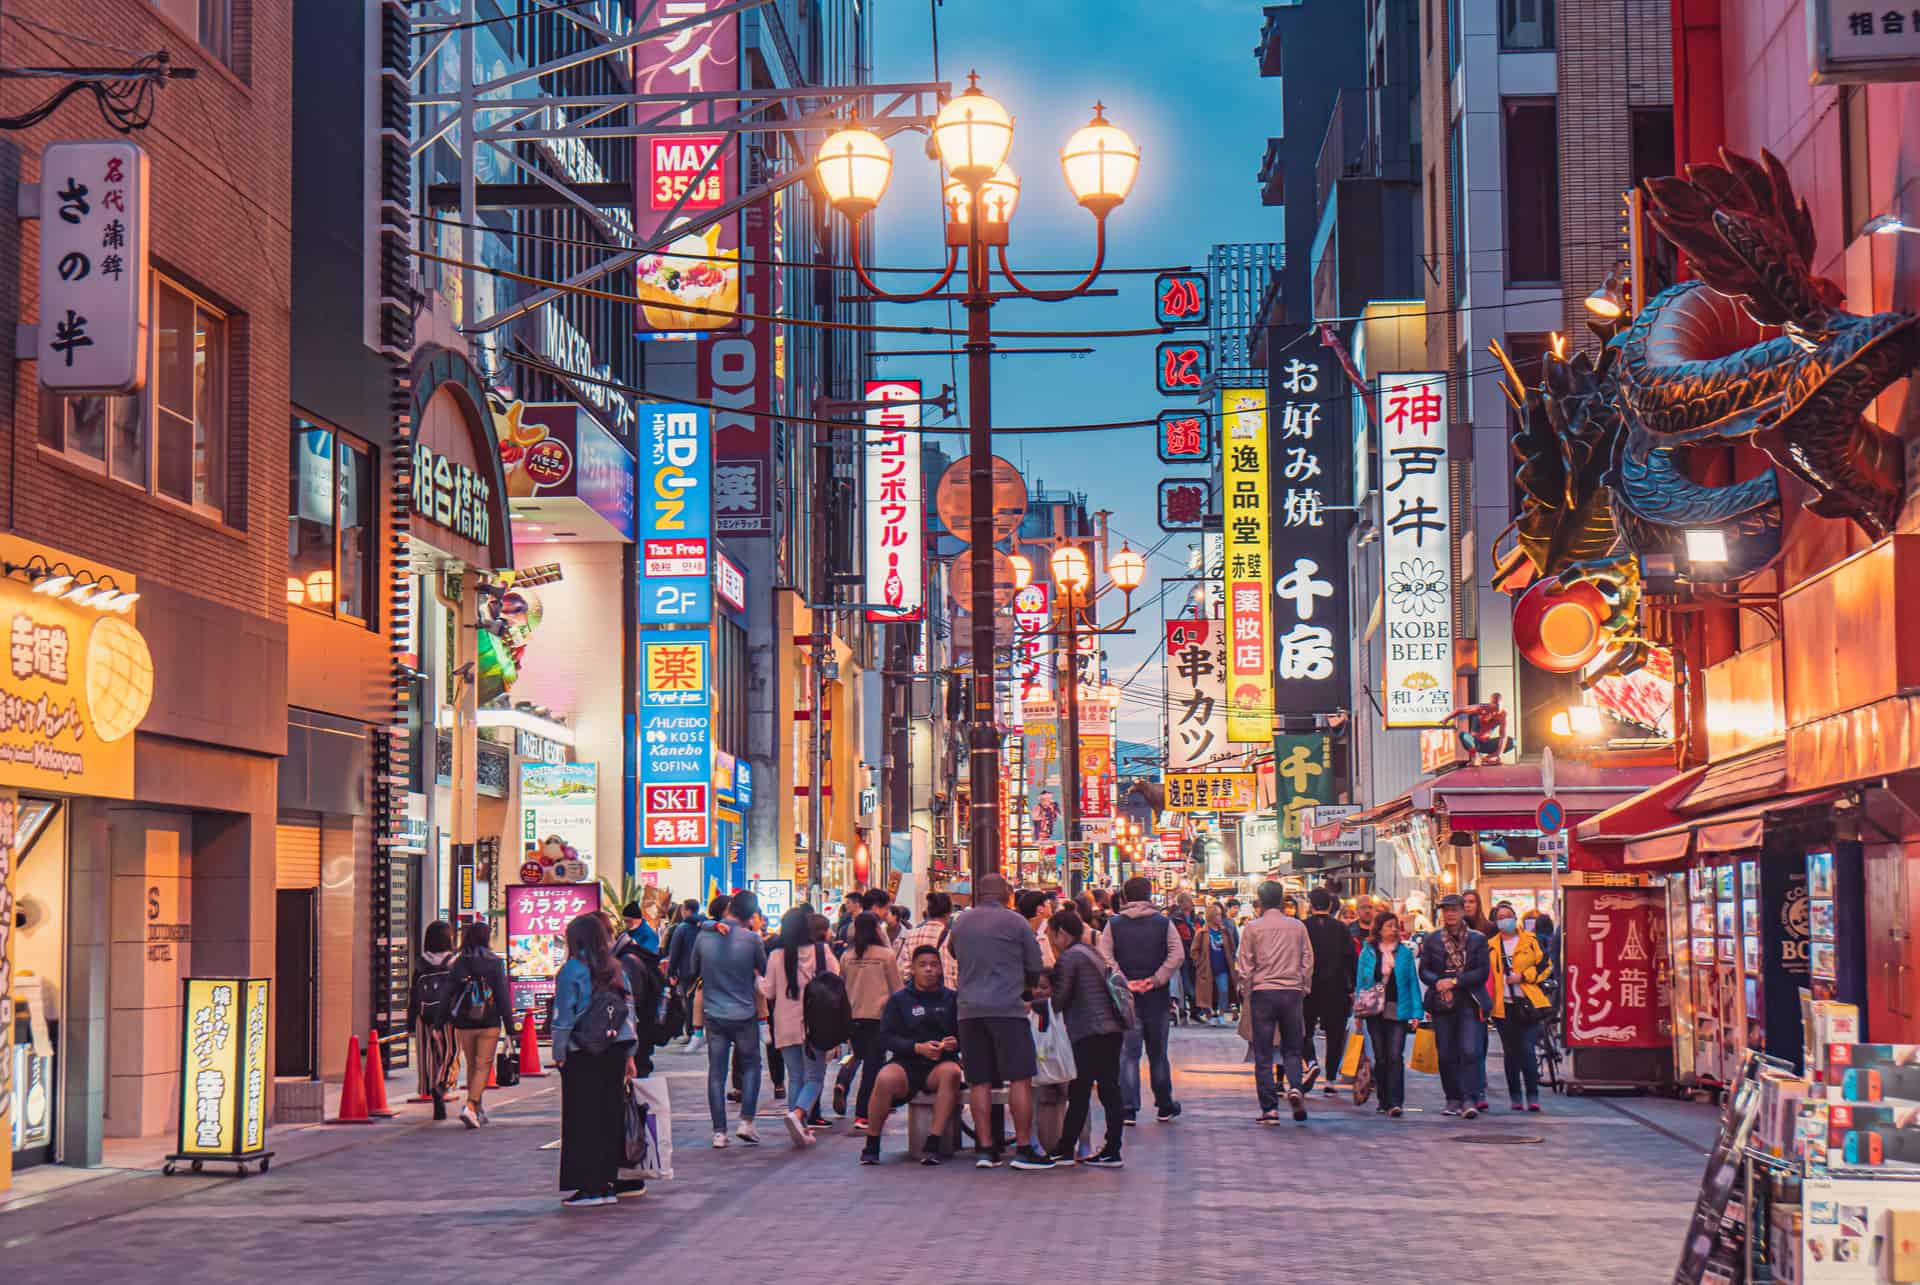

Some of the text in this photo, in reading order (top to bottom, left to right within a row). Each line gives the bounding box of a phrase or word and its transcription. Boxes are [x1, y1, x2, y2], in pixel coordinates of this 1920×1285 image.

[656, 145, 719, 171] MAX
[101, 157, 124, 281] 名代蒲鉾
[50, 177, 94, 366] さの半
[654, 413, 698, 530] EDION
[880, 391, 908, 548] ドラゴンボウル
[1282, 359, 1324, 527] お好み焼
[1385, 385, 1447, 548] 神戸牛
[412, 443, 490, 547] 相合橋筋
[1231, 445, 1261, 545] 逸品堂
[648, 544, 704, 555] Tax Free
[1232, 553, 1262, 578] 赤壁
[656, 586, 697, 614] 2F
[1276, 558, 1334, 680] 千房
[1390, 621, 1450, 639] KOBE
[11, 614, 68, 684] 幸福堂
[654, 647, 697, 689] 薬
[1392, 643, 1448, 661] BEEF
[644, 716, 708, 729] SHISEIDO
[1177, 645, 1214, 762] 串カツ
[1392, 690, 1449, 705] 和ノ宮
[649, 744, 703, 757] Kanebo
[652, 761, 700, 772] SOFINA
[654, 819, 699, 841] 免税
[519, 897, 587, 914] カラオケ
[1588, 914, 1612, 1023] ラーメン
[1618, 920, 1648, 1008] 金龍
[196, 1069, 225, 1148] 幸福堂
